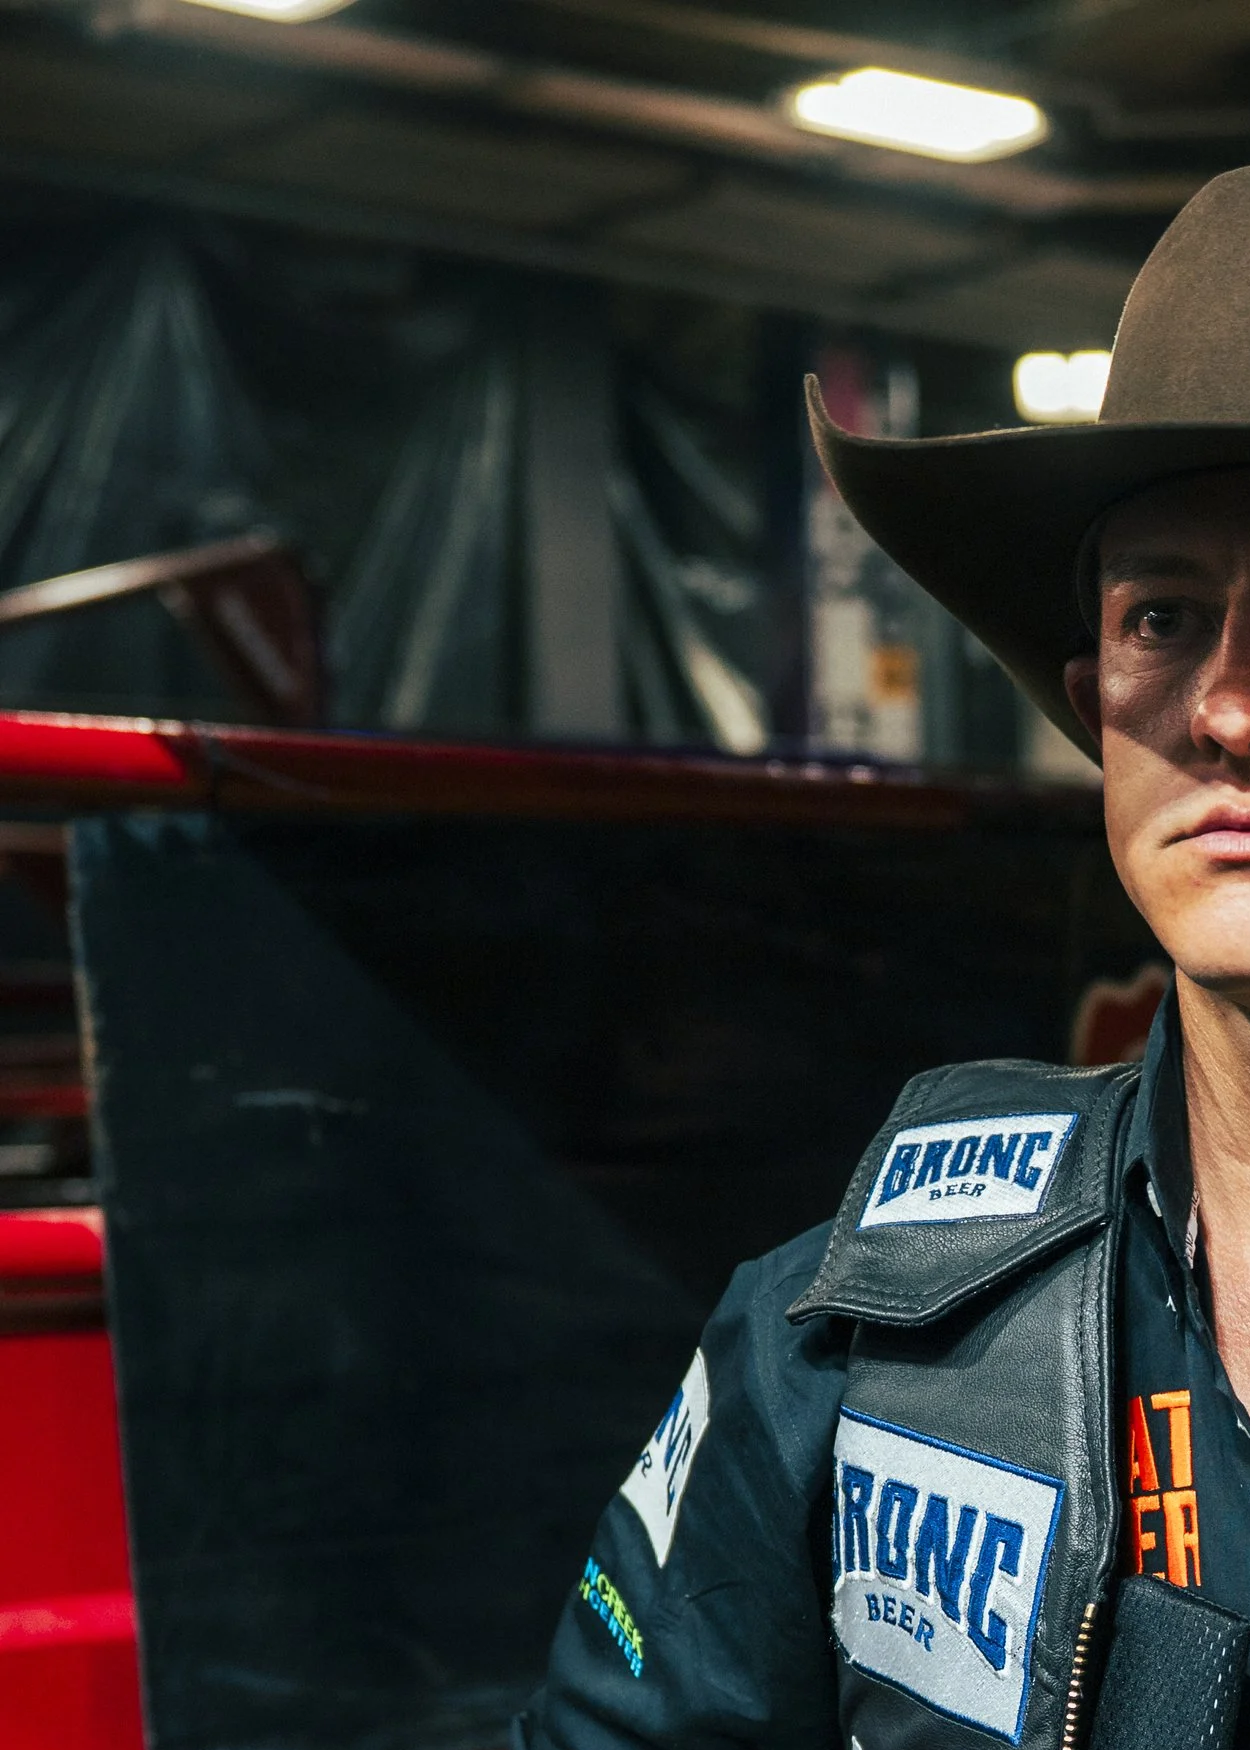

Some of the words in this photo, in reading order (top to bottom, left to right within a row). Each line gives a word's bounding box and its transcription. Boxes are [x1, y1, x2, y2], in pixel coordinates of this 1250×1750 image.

[876, 1131, 1053, 1208] BRONC
[929, 1183, 987, 1202] BEER
[832, 1456, 1024, 1672] RONC
[865, 1592, 935, 1652] BEER
